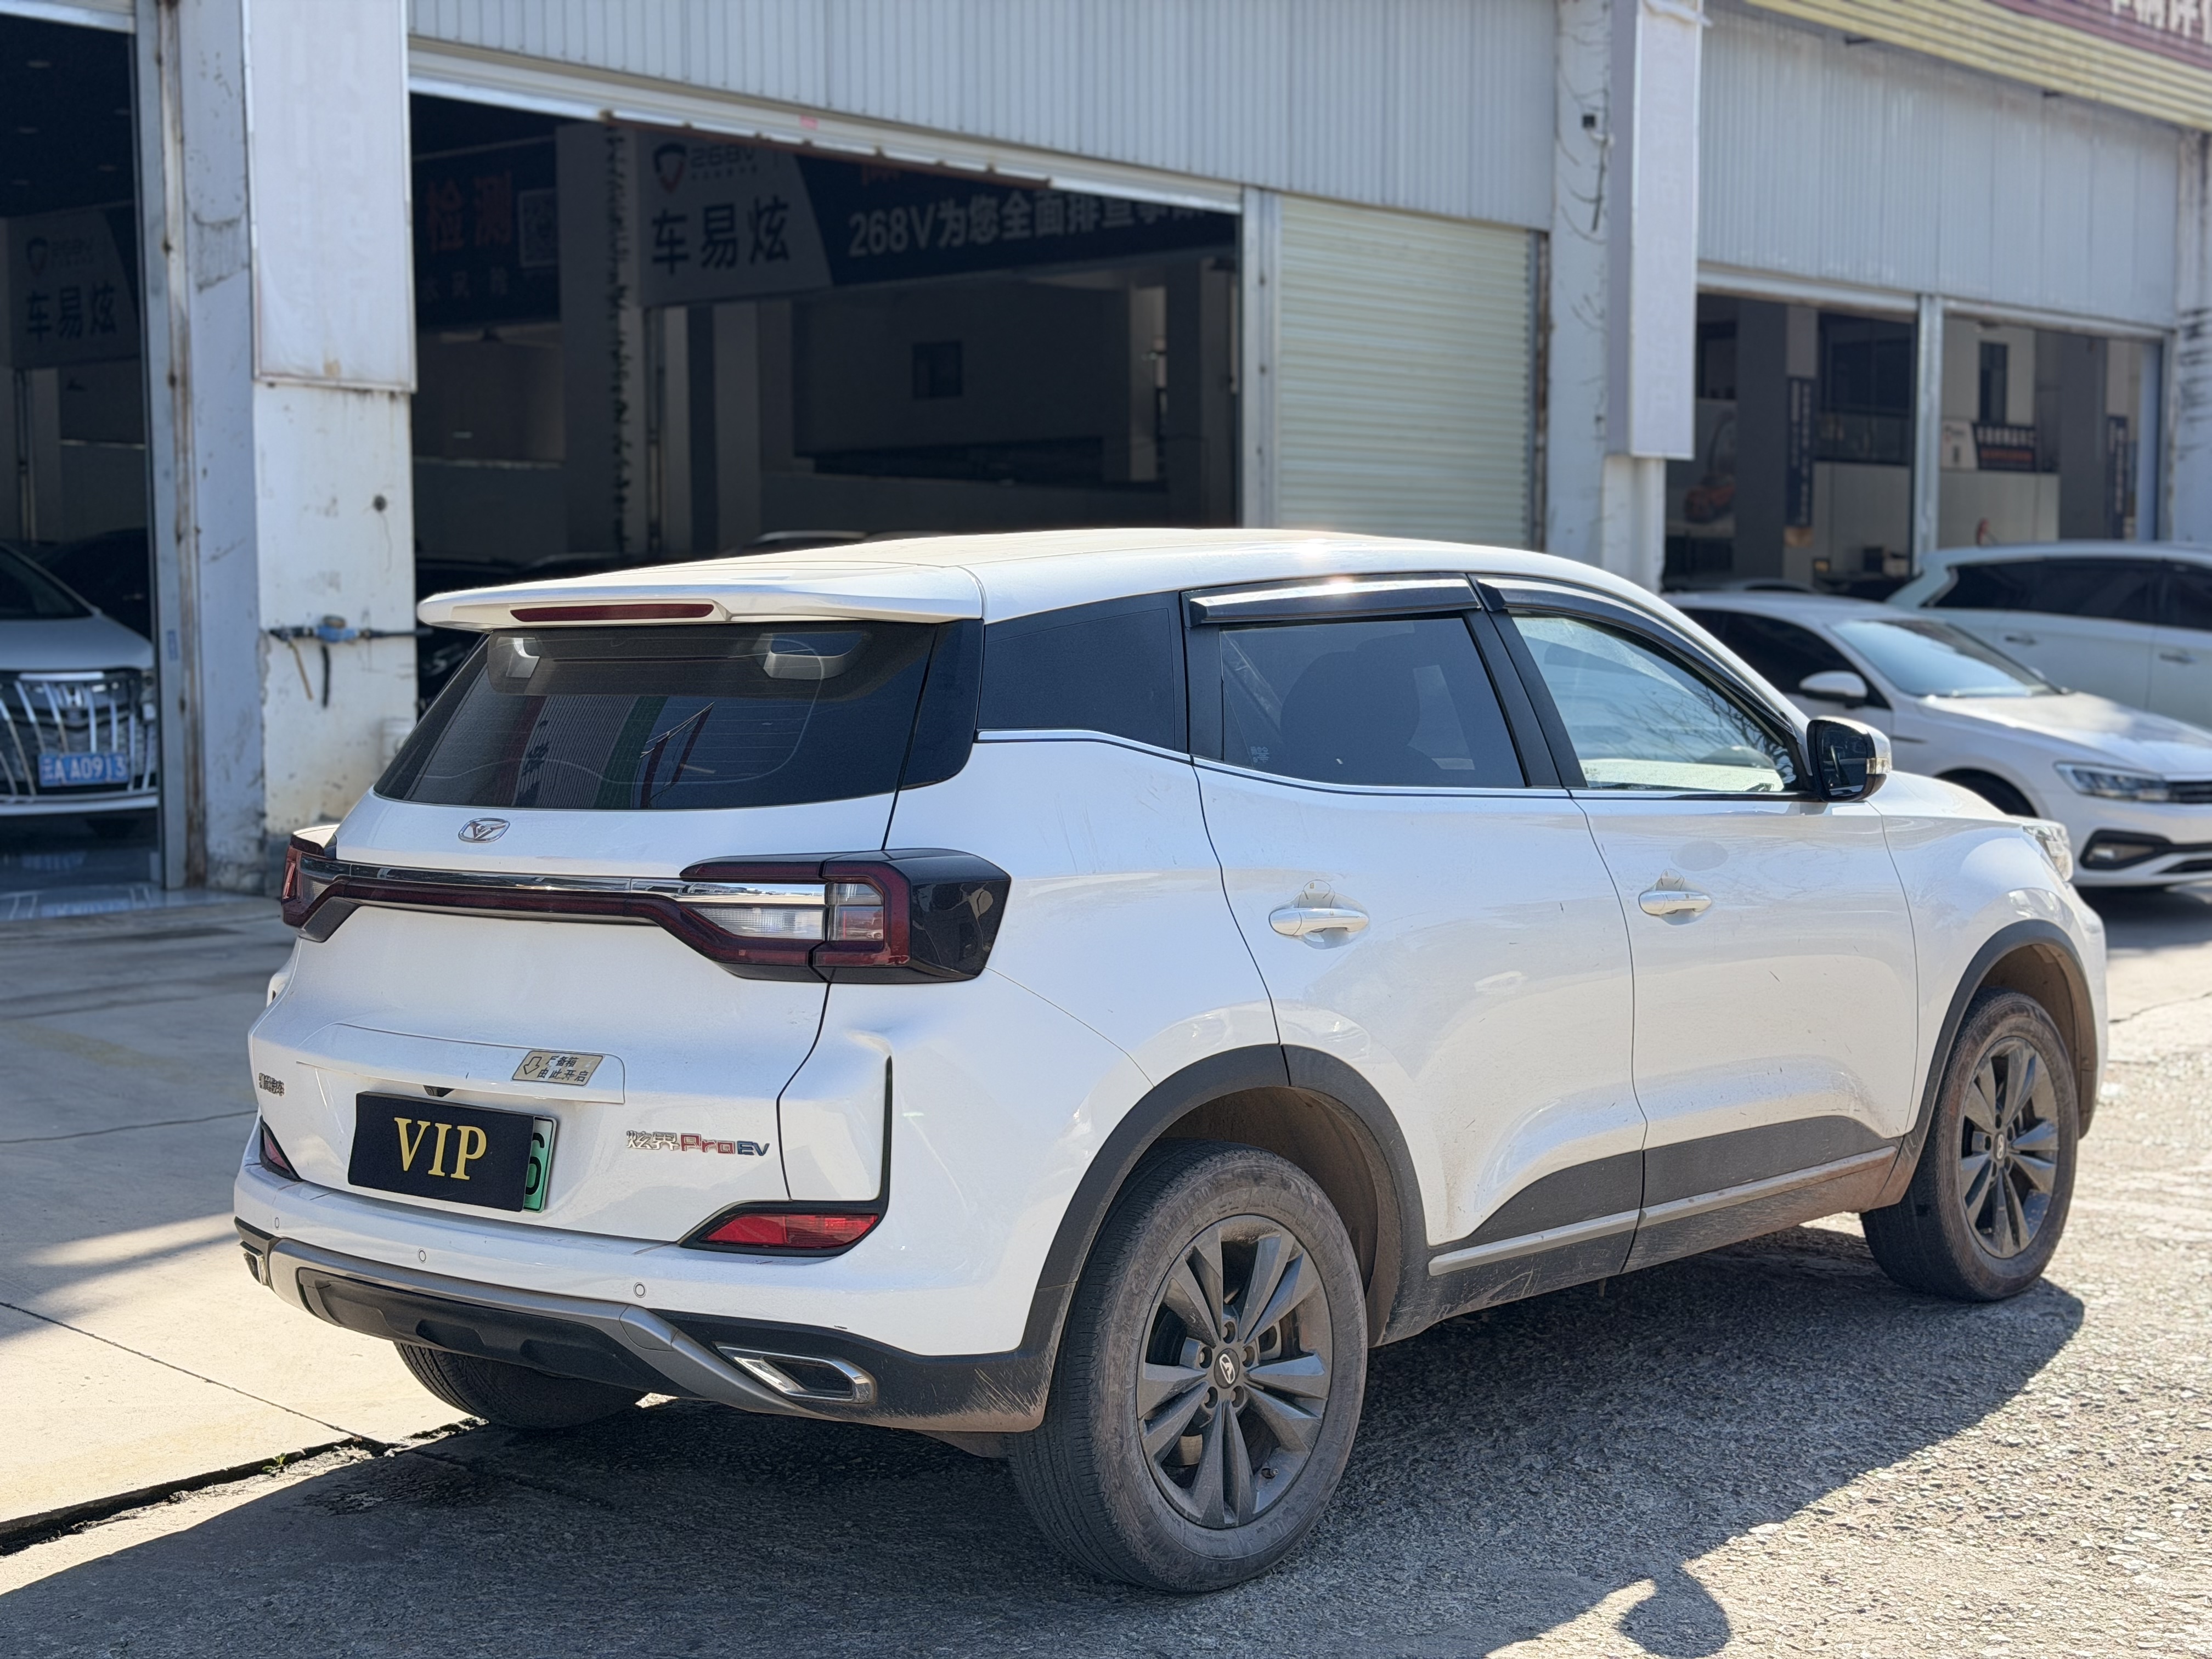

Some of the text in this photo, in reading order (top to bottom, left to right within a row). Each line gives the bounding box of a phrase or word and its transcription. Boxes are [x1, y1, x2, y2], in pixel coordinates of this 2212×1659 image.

[651, 195, 789, 275] 车易炫
[26, 279, 117, 342] 车易炫
[537, 1068, 589, 1082] 由此开启
[394, 1116, 487, 1180] VIP
